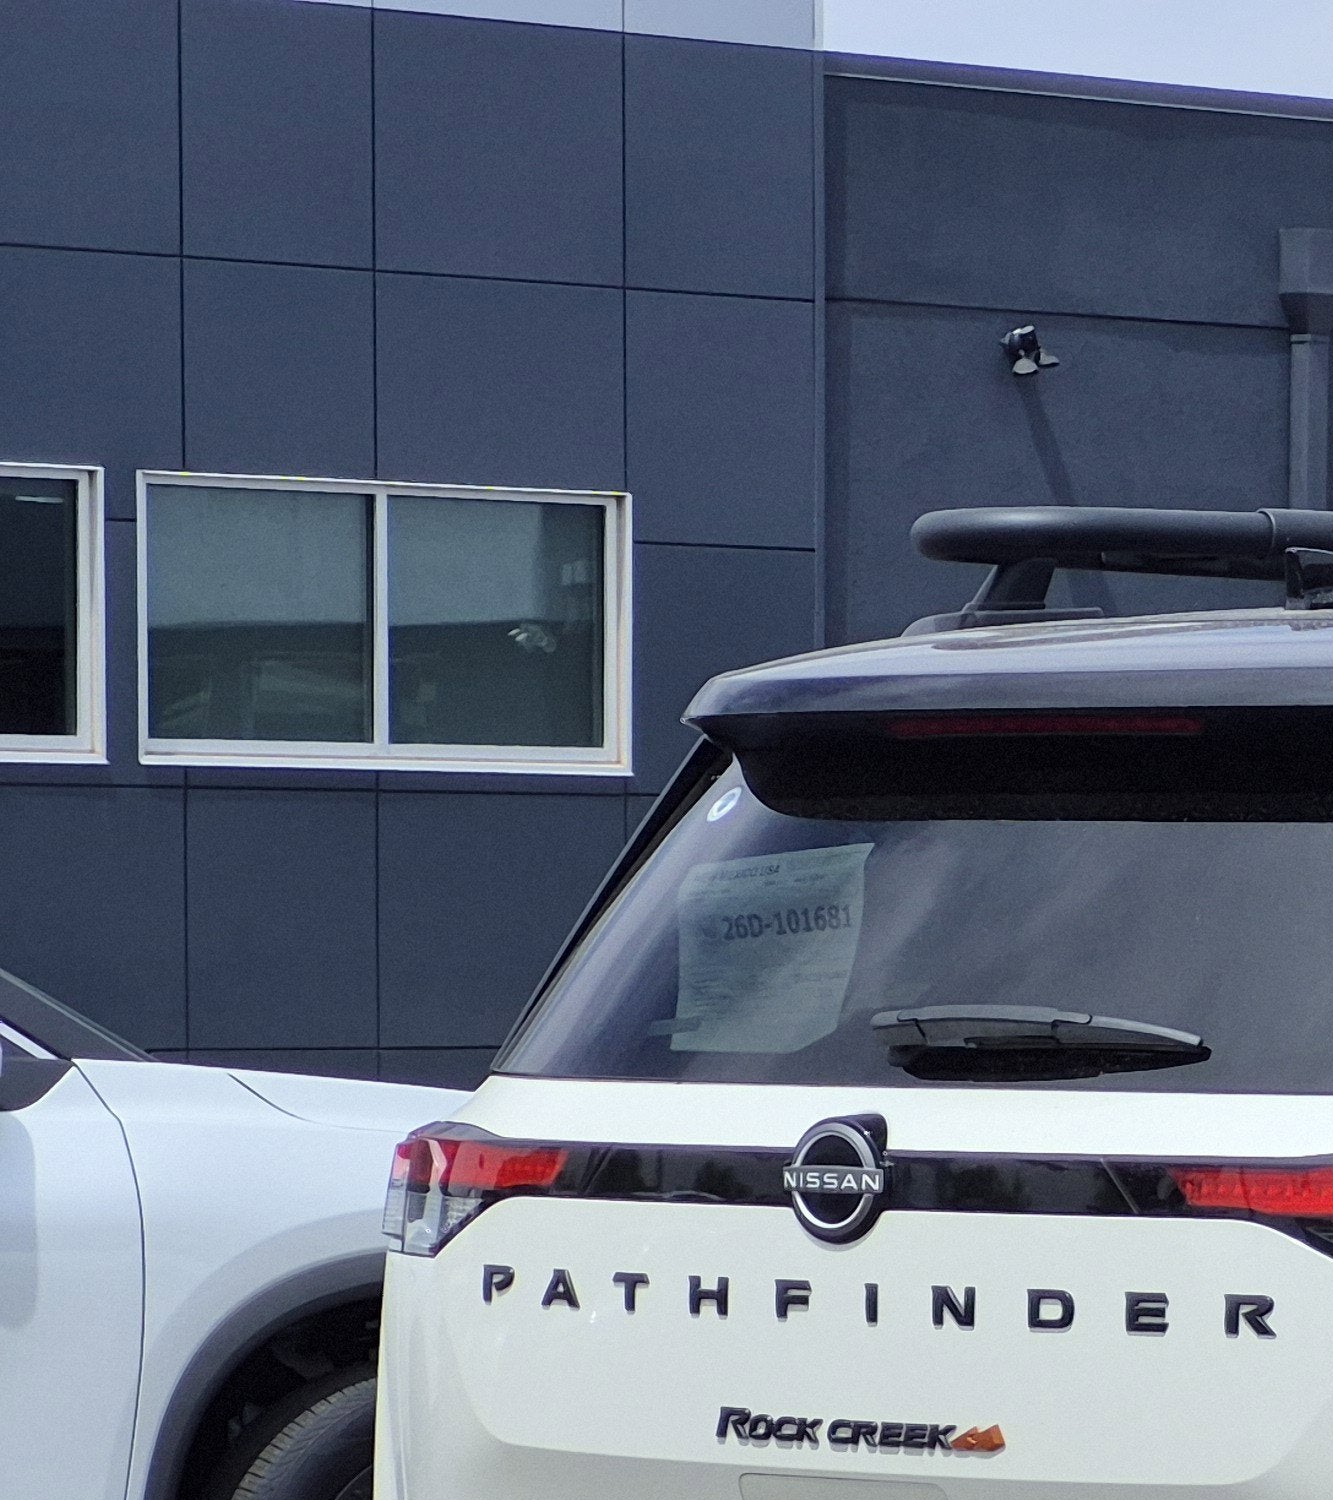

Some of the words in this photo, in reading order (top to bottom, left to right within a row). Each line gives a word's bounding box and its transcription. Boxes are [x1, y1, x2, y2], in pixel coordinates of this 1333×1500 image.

[722, 904, 850, 941] 26D-101681
[783, 1171, 880, 1191] NISSAN
[481, 1264, 1277, 1339] PATHFINDER
[716, 1406, 823, 1444] ROCK
[827, 1418, 957, 1450] CREEK
